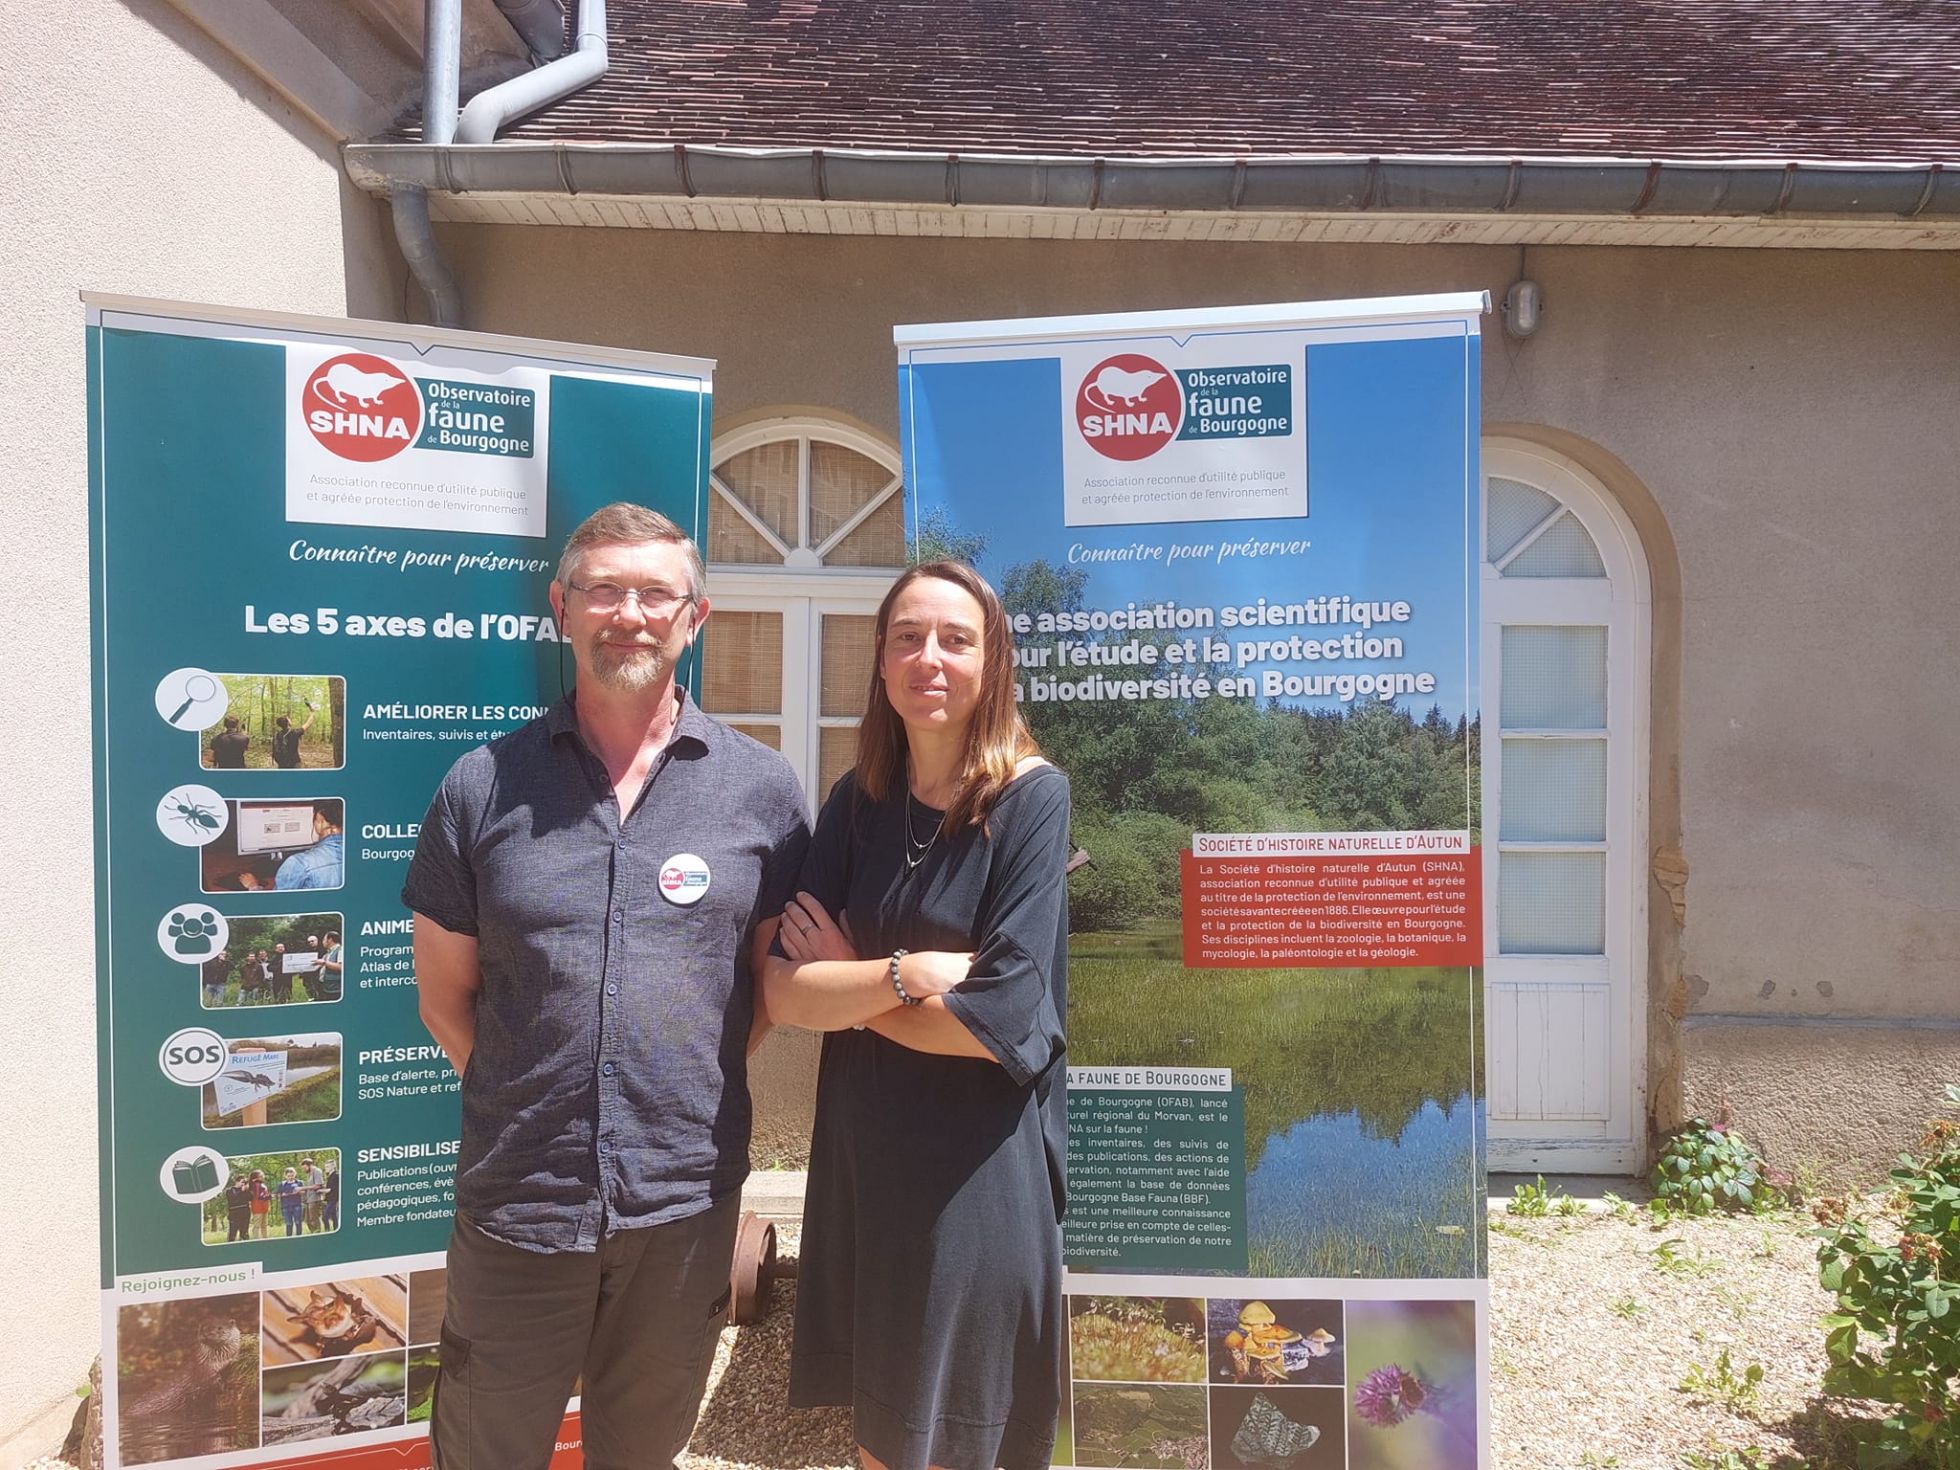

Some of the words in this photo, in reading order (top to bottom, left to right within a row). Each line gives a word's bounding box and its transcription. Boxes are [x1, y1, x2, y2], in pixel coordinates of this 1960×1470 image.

[1188, 368, 1288, 388] Observatoire
[428, 382, 530, 407] Observatoire
[1188, 392, 1262, 416] faune
[310, 410, 410, 440] SHNA
[428, 402, 504, 433] faune
[1083, 412, 1174, 436] SHNA
[1189, 426, 1198, 434] de
[1200, 416, 1288, 436] Bourgogne
[427, 435, 438, 444] de
[440, 430, 530, 454] Bourgogne
[310, 474, 378, 488] Association
[381, 480, 434, 492] reconnue
[437, 482, 477, 496] d'utilité
[480, 487, 526, 500] publique
[1084, 476, 1144, 488] Association
[1147, 475, 1196, 486] reconnue
[1199, 472, 1237, 482] d'utilité
[1240, 470, 1286, 483] publique
[306, 492, 318, 501] et
[321, 493, 362, 504] agréée
[365, 496, 424, 508] protection
[427, 500, 440, 509] de
[443, 500, 528, 516] l'environnement
[1082, 496, 1092, 504] et
[1094, 493, 1130, 506] agréée
[1133, 491, 1188, 504] protection
[1190, 490, 1202, 500] de
[1206, 488, 1288, 499] l'environnement
[289, 539, 397, 566] Connaître
[401, 552, 451, 573] pour
[454, 551, 550, 575] préserver
[1068, 543, 1162, 564] Connaître
[1166, 544, 1214, 567] pour
[1217, 538, 1312, 566] préserver
[244, 605, 310, 634] Les
[316, 608, 338, 635] 5
[345, 614, 426, 638] axes
[432, 612, 474, 640] de
[1038, 602, 1214, 633] association
[1220, 596, 1410, 629] scientifique
[1058, 640, 1158, 667] l'étude
[1165, 641, 1196, 665] et
[1204, 638, 1230, 663] la
[1237, 632, 1402, 668] protection
[1031, 671, 1212, 702] biodiversité
[1217, 676, 1256, 698] en
[1262, 670, 1436, 701] Bourgogne
[363, 701, 468, 720] AMÉLIORER
[472, 706, 504, 720] LES
[363, 729, 436, 742] Inventaires,
[438, 730, 474, 740] suivis
[476, 731, 488, 740] et
[1200, 865, 1213, 874] La
[1220, 864, 1260, 874] Société
[1266, 864, 1316, 874] d'histoire
[1323, 863, 1370, 873] naturelle
[1376, 862, 1416, 872] d'Autun
[1200, 878, 1260, 888] association
[1264, 880, 1314, 888] reconnue
[1318, 878, 1358, 887] d'utilité
[1362, 878, 1408, 888] publique
[1428, 877, 1466, 888] agréée
[1215, 892, 1238, 902] titre
[1240, 893, 1252, 902] de
[1254, 892, 1263, 902] la
[1266, 892, 1320, 904] protection
[1322, 892, 1336, 901] de
[1426, 892, 1443, 900] est
[1446, 892, 1466, 900] une
[360, 920, 414, 936] ANIME
[1216, 920, 1226, 930] la
[1230, 920, 1284, 932] protection
[1290, 920, 1302, 929] de
[1306, 920, 1316, 929] la
[1320, 919, 1382, 929] biodiversité
[1387, 920, 1400, 928] en
[1404, 918, 1466, 930] Bourgogne.
[1202, 934, 1220, 944] Ses
[1224, 934, 1279, 946] disciplines
[1281, 934, 1323, 944] incluent
[1326, 934, 1334, 942] la
[1386, 933, 1396, 942] la
[1456, 932, 1466, 942] la
[1260, 948, 1270, 958] la
[1272, 948, 1344, 959] paléontologie
[1346, 949, 1356, 957] et
[1359, 948, 1368, 957] la
[1370, 948, 1419, 959] géologie.
[360, 961, 392, 973] Atlas
[394, 960, 409, 970] de
[360, 979, 372, 988] et
[168, 1045, 220, 1066] SOS
[359, 1074, 389, 1085] Base
[1078, 1072, 1120, 1084] FAUNE
[1125, 1072, 1141, 1084] DE
[358, 1088, 384, 1100] SOS
[386, 1084, 428, 1098] Nature
[430, 1083, 442, 1093] et
[1098, 1097, 1152, 1108] Bourgogne
[1200, 1098, 1228, 1108] lancé
[1093, 1110, 1132, 1122] régional
[1138, 1112, 1150, 1120] du
[1198, 1114, 1214, 1122] est
[1086, 1126, 1102, 1134] sur
[1114, 1124, 1142, 1134] faune
[1154, 1138, 1172, 1148] des
[1180, 1139, 1208, 1149] suivis
[357, 1140, 461, 1164] SENSIBILISE
[1154, 1152, 1172, 1162] des
[1176, 1153, 1214, 1163] actions
[358, 1166, 428, 1182] Publications
[1116, 1166, 1174, 1176] notamment
[1176, 1168, 1200, 1176] avec
[1204, 1167, 1230, 1178] l'aide
[358, 1180, 432, 1196] conférences,
[1070, 1179, 1122, 1190] également
[1127, 1179, 1136, 1188] la
[1140, 1180, 1164, 1190] base
[1170, 1180, 1182, 1190] de
[1187, 1180, 1230, 1191] données
[1066, 1192, 1119, 1204] Bourgogne
[1122, 1192, 1146, 1202] Base
[1148, 1193, 1178, 1203] Fauna
[1072, 1207, 1087, 1215] est
[1091, 1208, 1109, 1216] une
[1112, 1206, 1158, 1216] meilleure
[1162, 1208, 1231, 1218] connaissance
[357, 1216, 404, 1228] Membre
[1100, 1220, 1124, 1230] prise
[1127, 1222, 1140, 1230] en
[1142, 1222, 1180, 1232] compte
[1182, 1222, 1194, 1231] de
[1066, 1233, 1104, 1242] matière
[1107, 1233, 1120, 1242] de
[1122, 1234, 1186, 1246] préservation
[1189, 1235, 1201, 1244] de
[1204, 1236, 1232, 1246] notre
[122, 1271, 246, 1294] Rejoignez-nous
